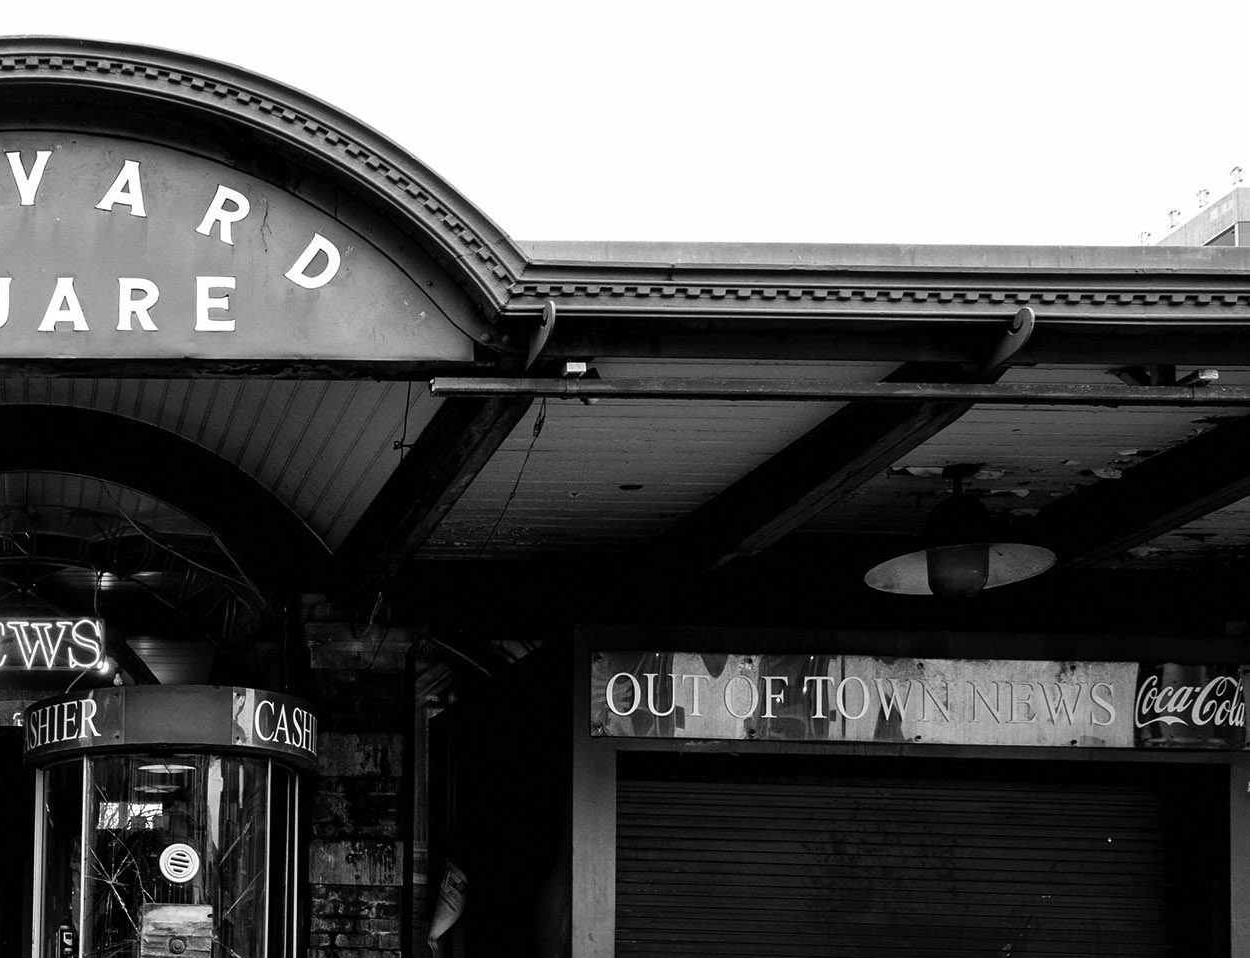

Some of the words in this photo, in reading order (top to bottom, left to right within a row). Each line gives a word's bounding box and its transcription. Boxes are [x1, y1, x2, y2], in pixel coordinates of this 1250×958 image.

[605, 672, 711, 717] OUT
[723, 674, 790, 719] OF
[803, 675, 951, 722] TOWN
[966, 679, 1117, 726] NEWS
[1135, 675, 1245, 728] Coca-Cola
